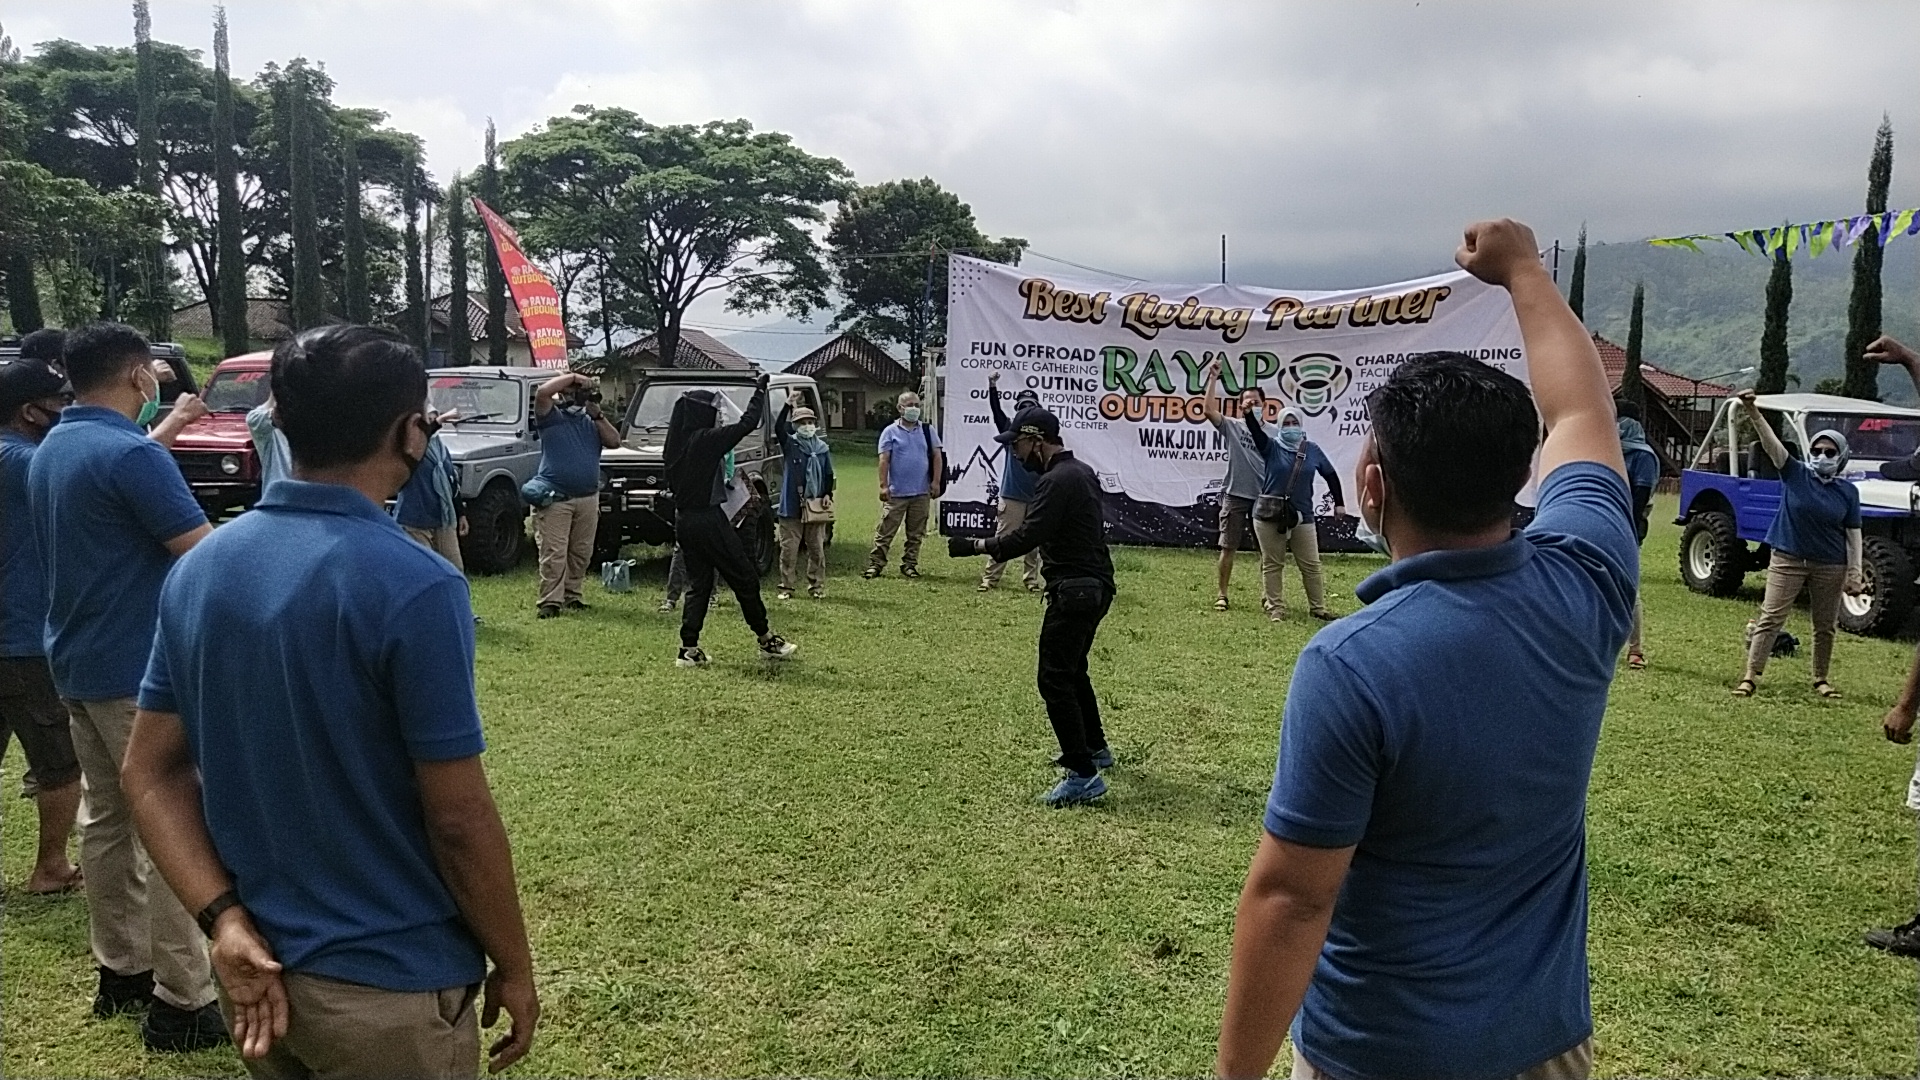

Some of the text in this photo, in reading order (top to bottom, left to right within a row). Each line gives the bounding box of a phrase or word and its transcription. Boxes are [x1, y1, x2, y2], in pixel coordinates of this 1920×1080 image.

[530, 296, 556, 306] RAYAP
[1019, 278, 1451, 343] Best Living Partner
[537, 328, 562, 338] RAYAP
[532, 337, 565, 349] UTBOUND
[971, 342, 1095, 361] FUN OFFROAD
[1356, 353, 1423, 366] CHARAC
[961, 358, 1098, 375] CORPORATE GATHERING
[1099, 346, 1280, 396] RAYAP
[1361, 368, 1396, 378] FACIL
[1026, 375, 1098, 392] OUTING
[1043, 393, 1096, 405] PROVIDER
[1047, 405, 1098, 420] FTING
[963, 415, 990, 423] TEAM
[1075, 421, 1108, 430] CENTER
[1339, 424, 1371, 436] HAV
[1139, 428, 1206, 449] WAKJON
[1148, 449, 1229, 461] WWW.RAYAPG
[947, 512, 984, 528] OFFICE
